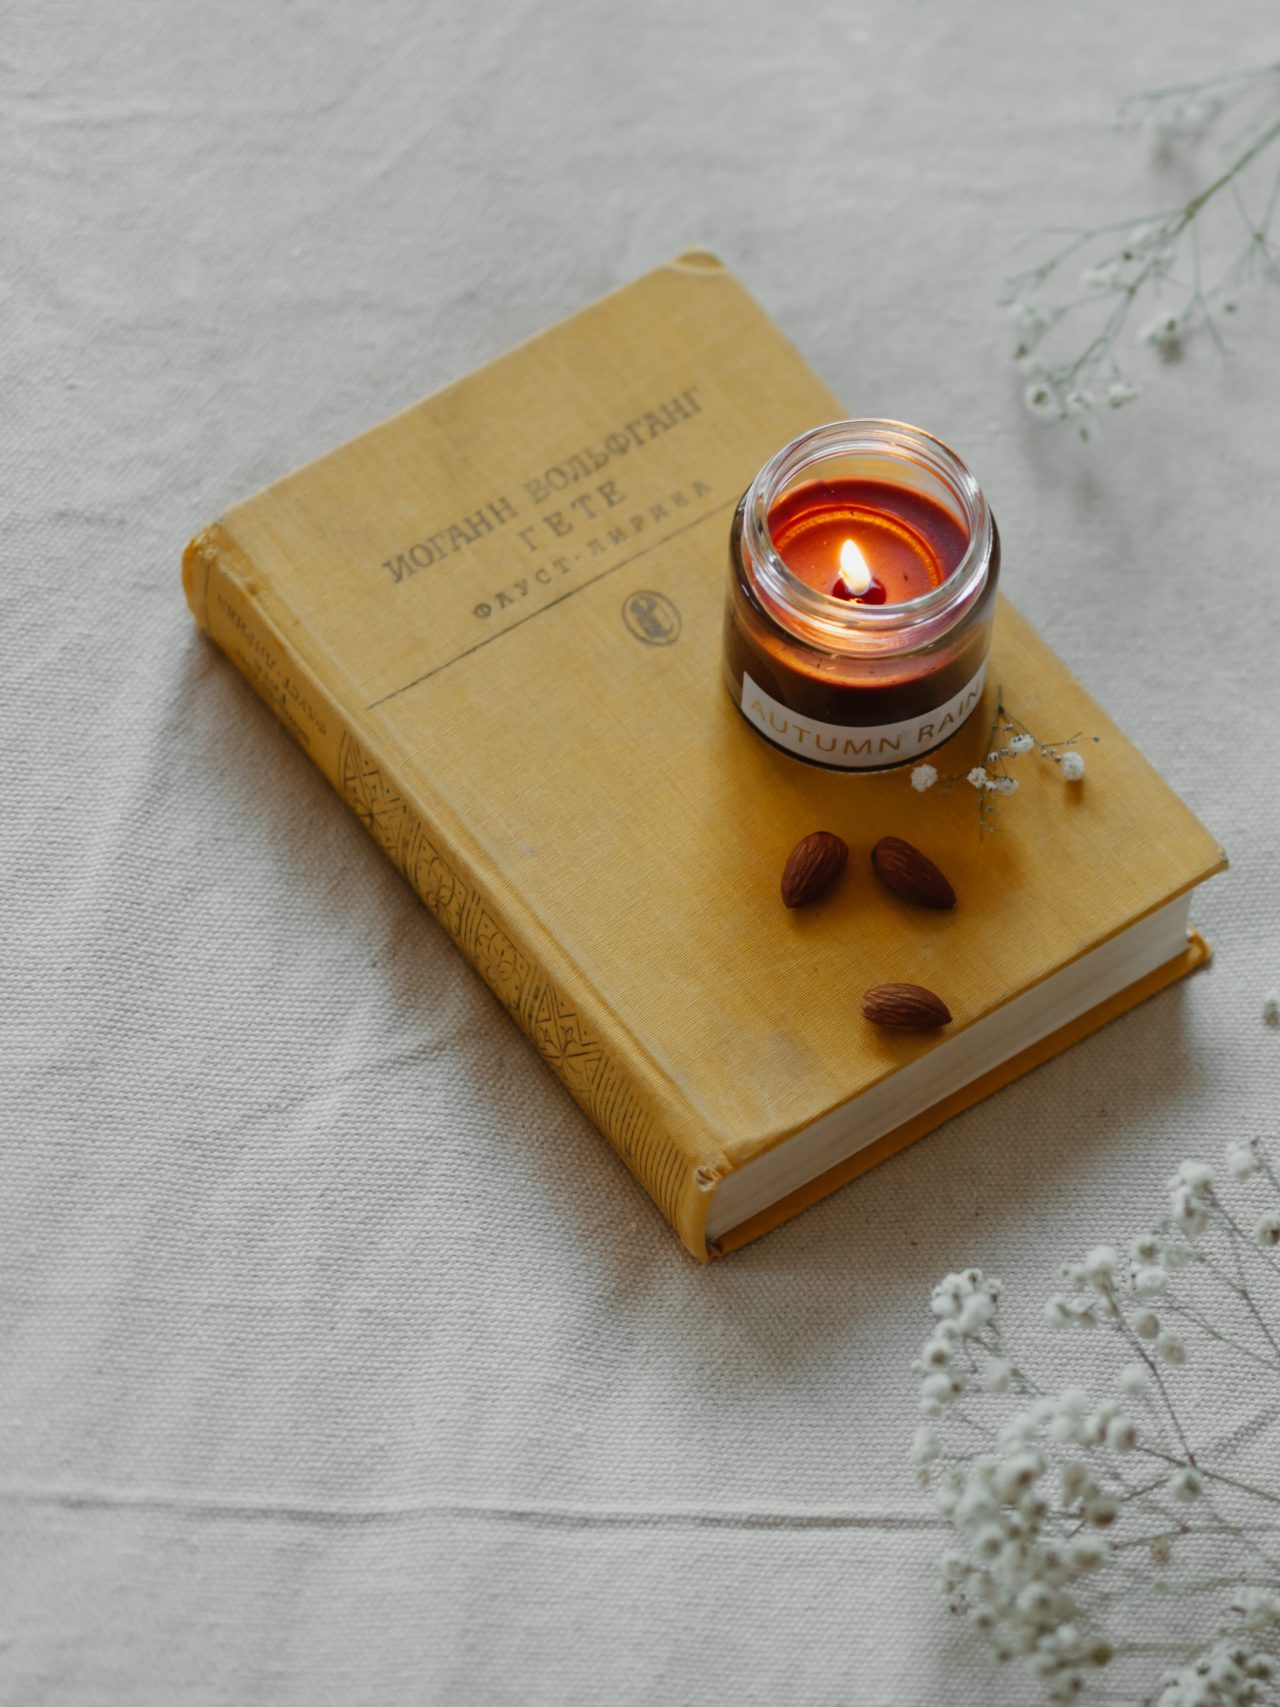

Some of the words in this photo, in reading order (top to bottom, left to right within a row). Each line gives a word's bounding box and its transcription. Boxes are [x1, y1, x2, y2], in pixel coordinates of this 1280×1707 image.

[382, 497, 520, 584] ИОГАНН
[522, 387, 704, 508] ВОЛЬФГАНГ
[516, 480, 627, 553] ГЕТЕ
[586, 479, 713, 556] ЛИРИКА
[750, 698, 903, 756] AUTUMN
[916, 679, 981, 744] RAIN
